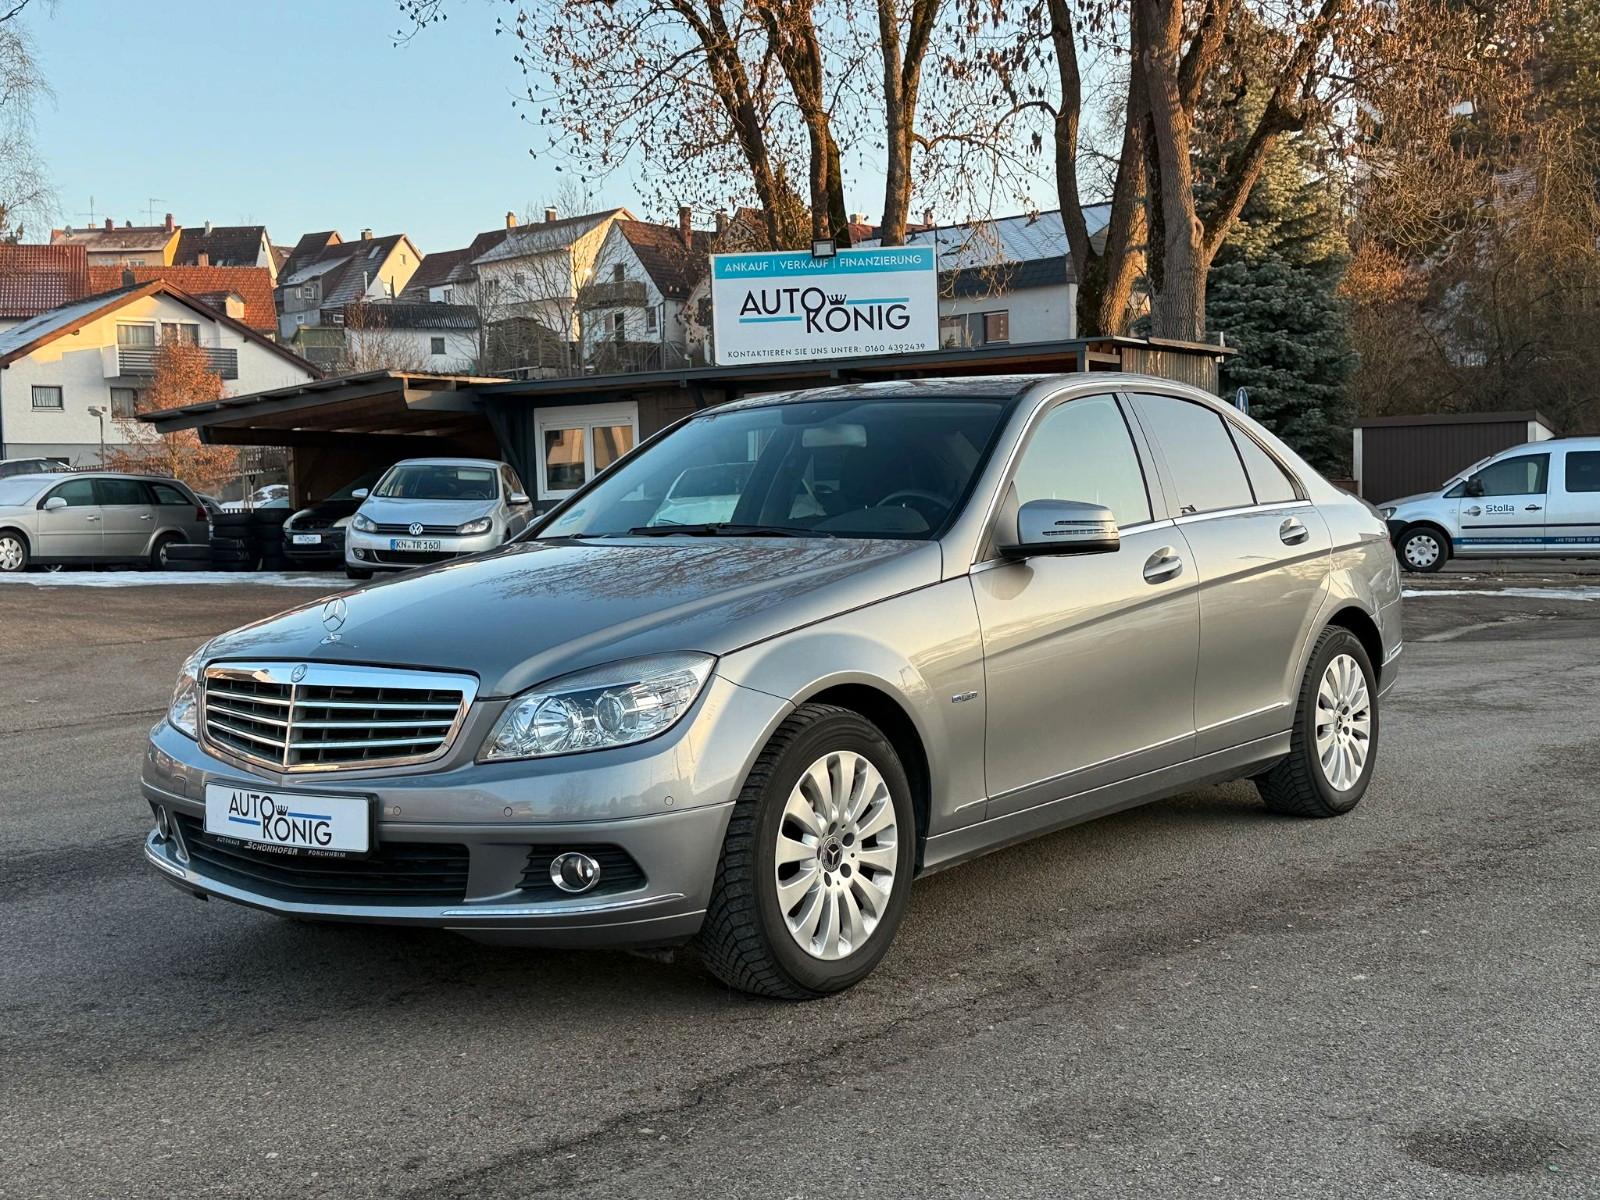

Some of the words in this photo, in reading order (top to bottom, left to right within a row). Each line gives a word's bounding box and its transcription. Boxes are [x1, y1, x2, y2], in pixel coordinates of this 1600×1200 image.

[724, 261, 769, 272] ANKAUF
[780, 258, 829, 270] VERKAUF
[839, 254, 922, 267] FINANZIERUNG
[739, 287, 826, 316] AUTO
[727, 349, 792, 358] KONTAKTIEREN
[795, 348, 808, 356] SIE
[810, 347, 828, 355] UNS
[831, 345, 862, 354] UNTER:
[865, 344, 885, 353] 0160
[888, 343, 926, 352] 4392439
[1485, 504, 1515, 512] Stolla
[228, 792, 275, 818] AUTO
